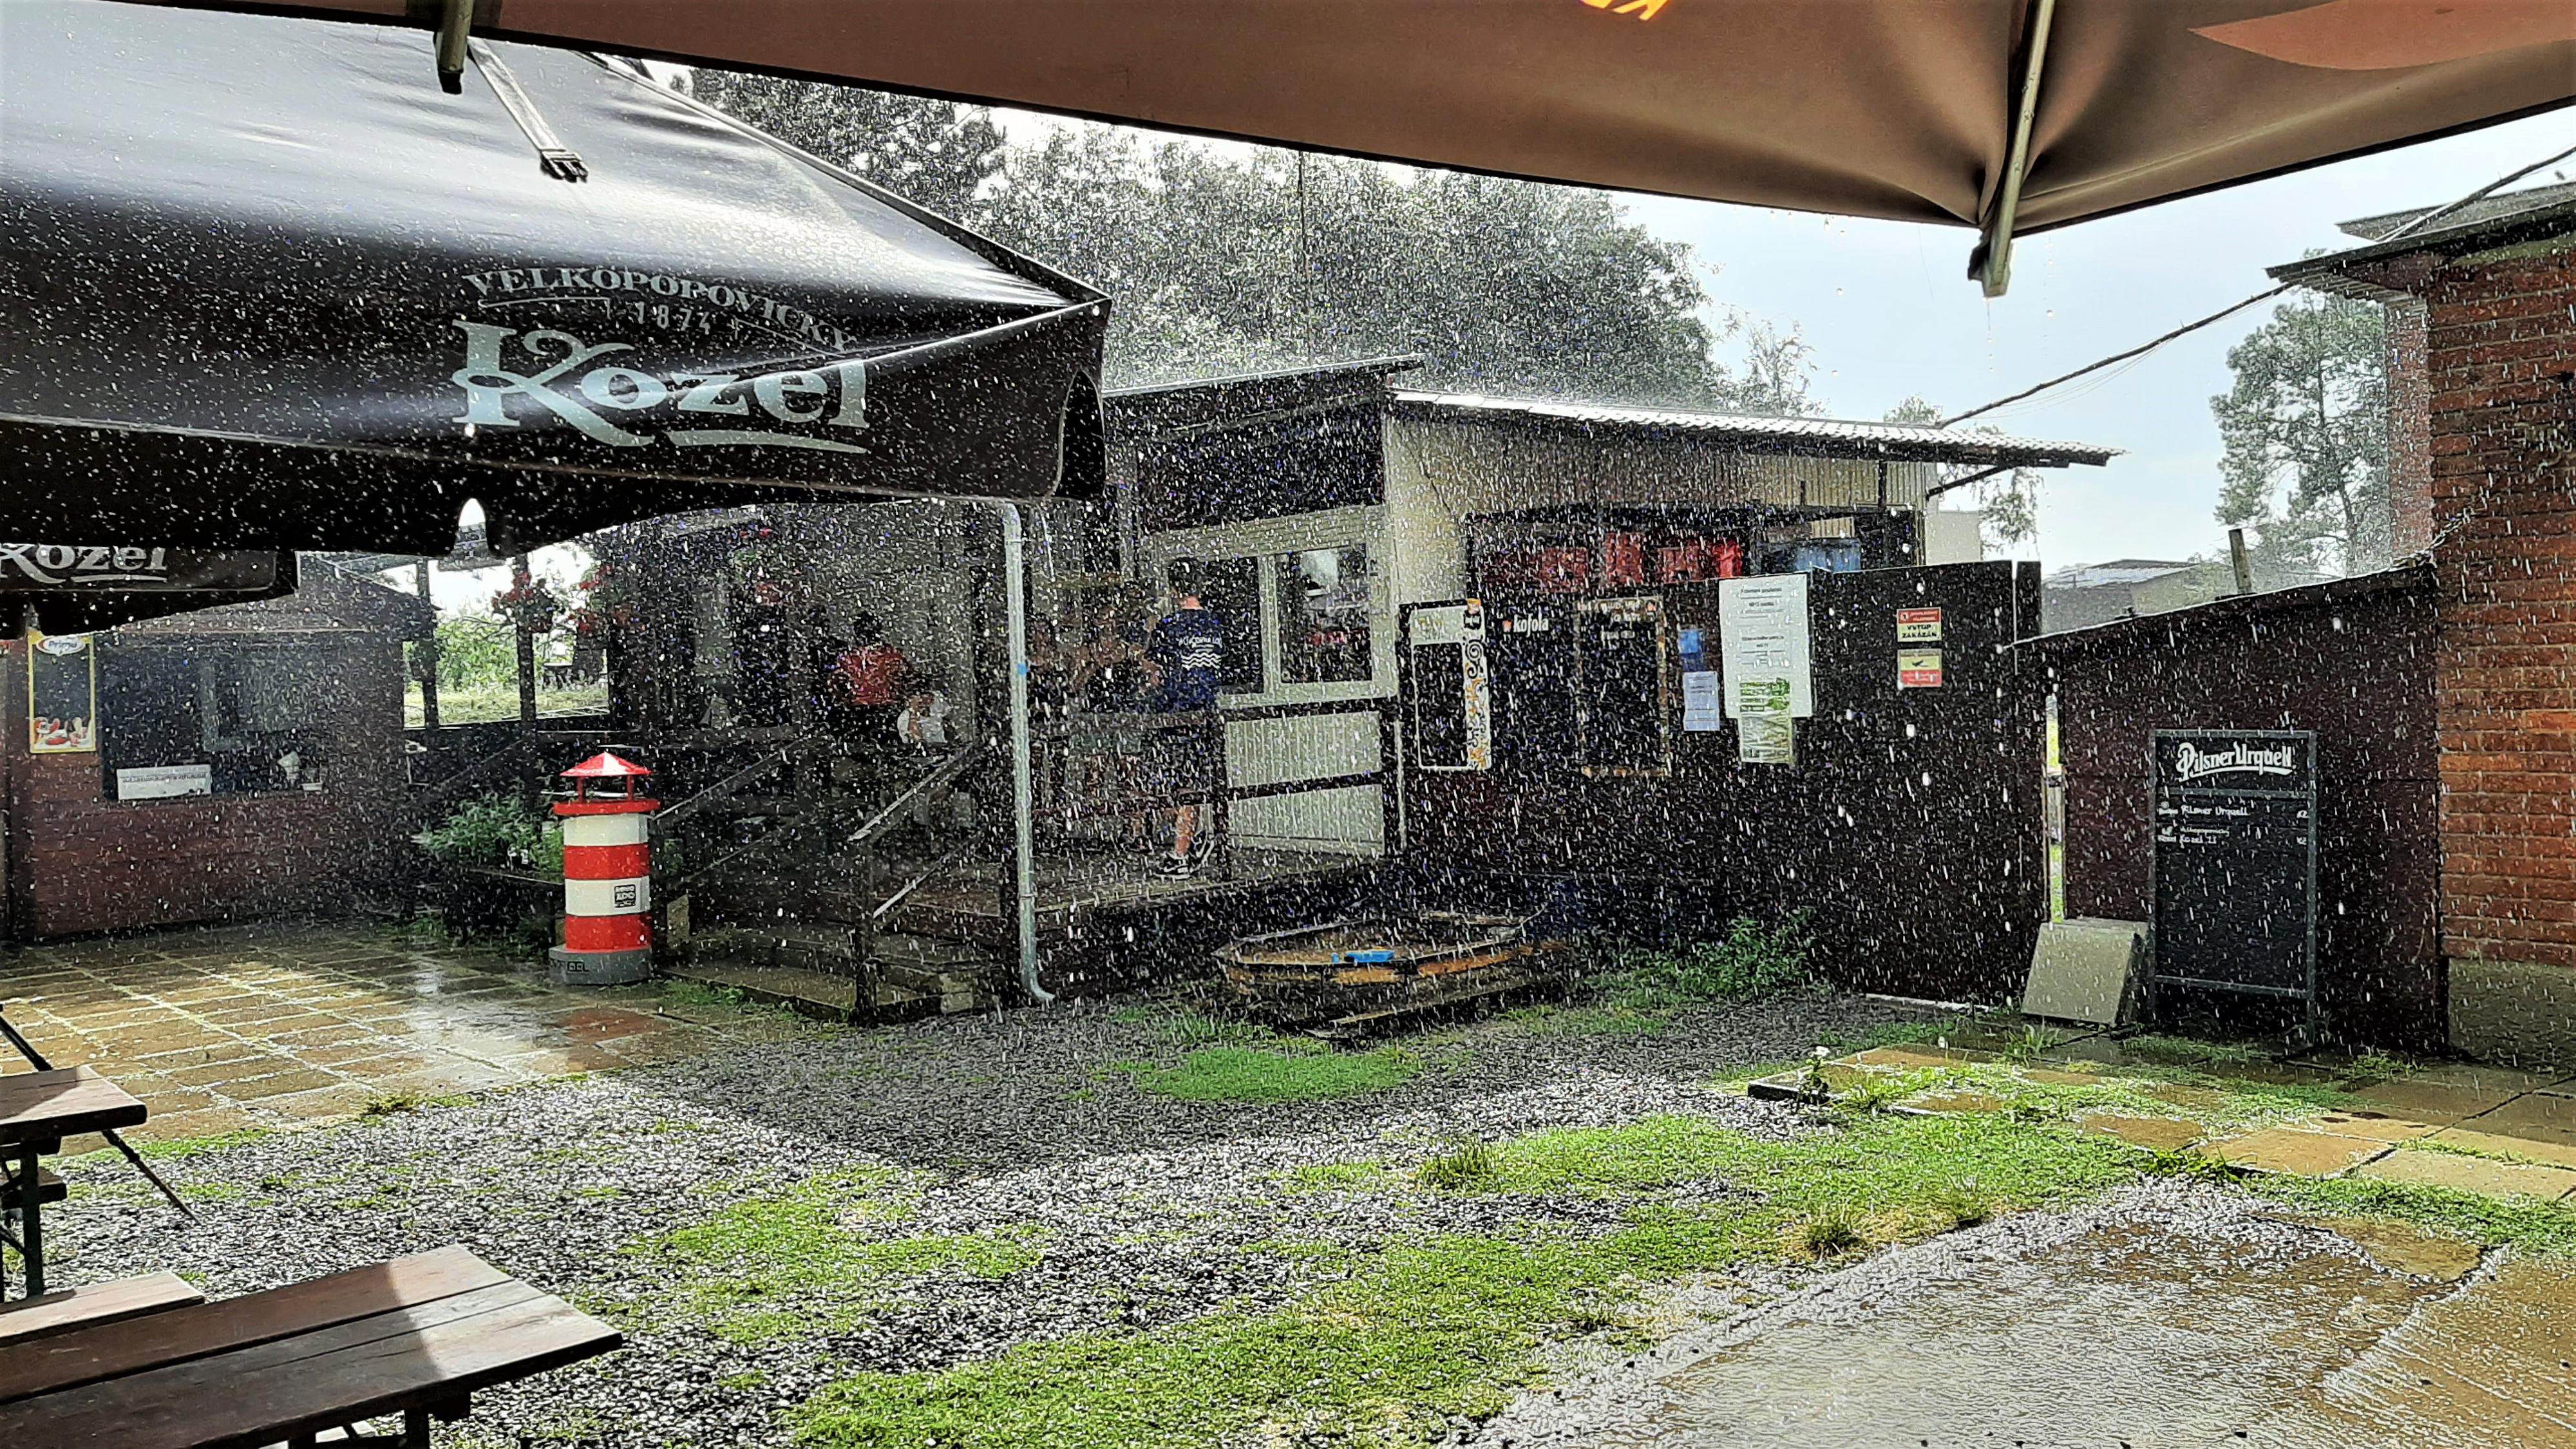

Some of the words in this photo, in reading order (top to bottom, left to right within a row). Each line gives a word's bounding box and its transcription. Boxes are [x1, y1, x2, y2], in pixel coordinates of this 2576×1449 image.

[634, 301, 711, 335] 1874
[451, 321, 869, 446] Kozel
[1513, 613, 1549, 638] kofola
[2175, 742, 2235, 782] Pilsner
[2233, 741, 2292, 776] Urquell
